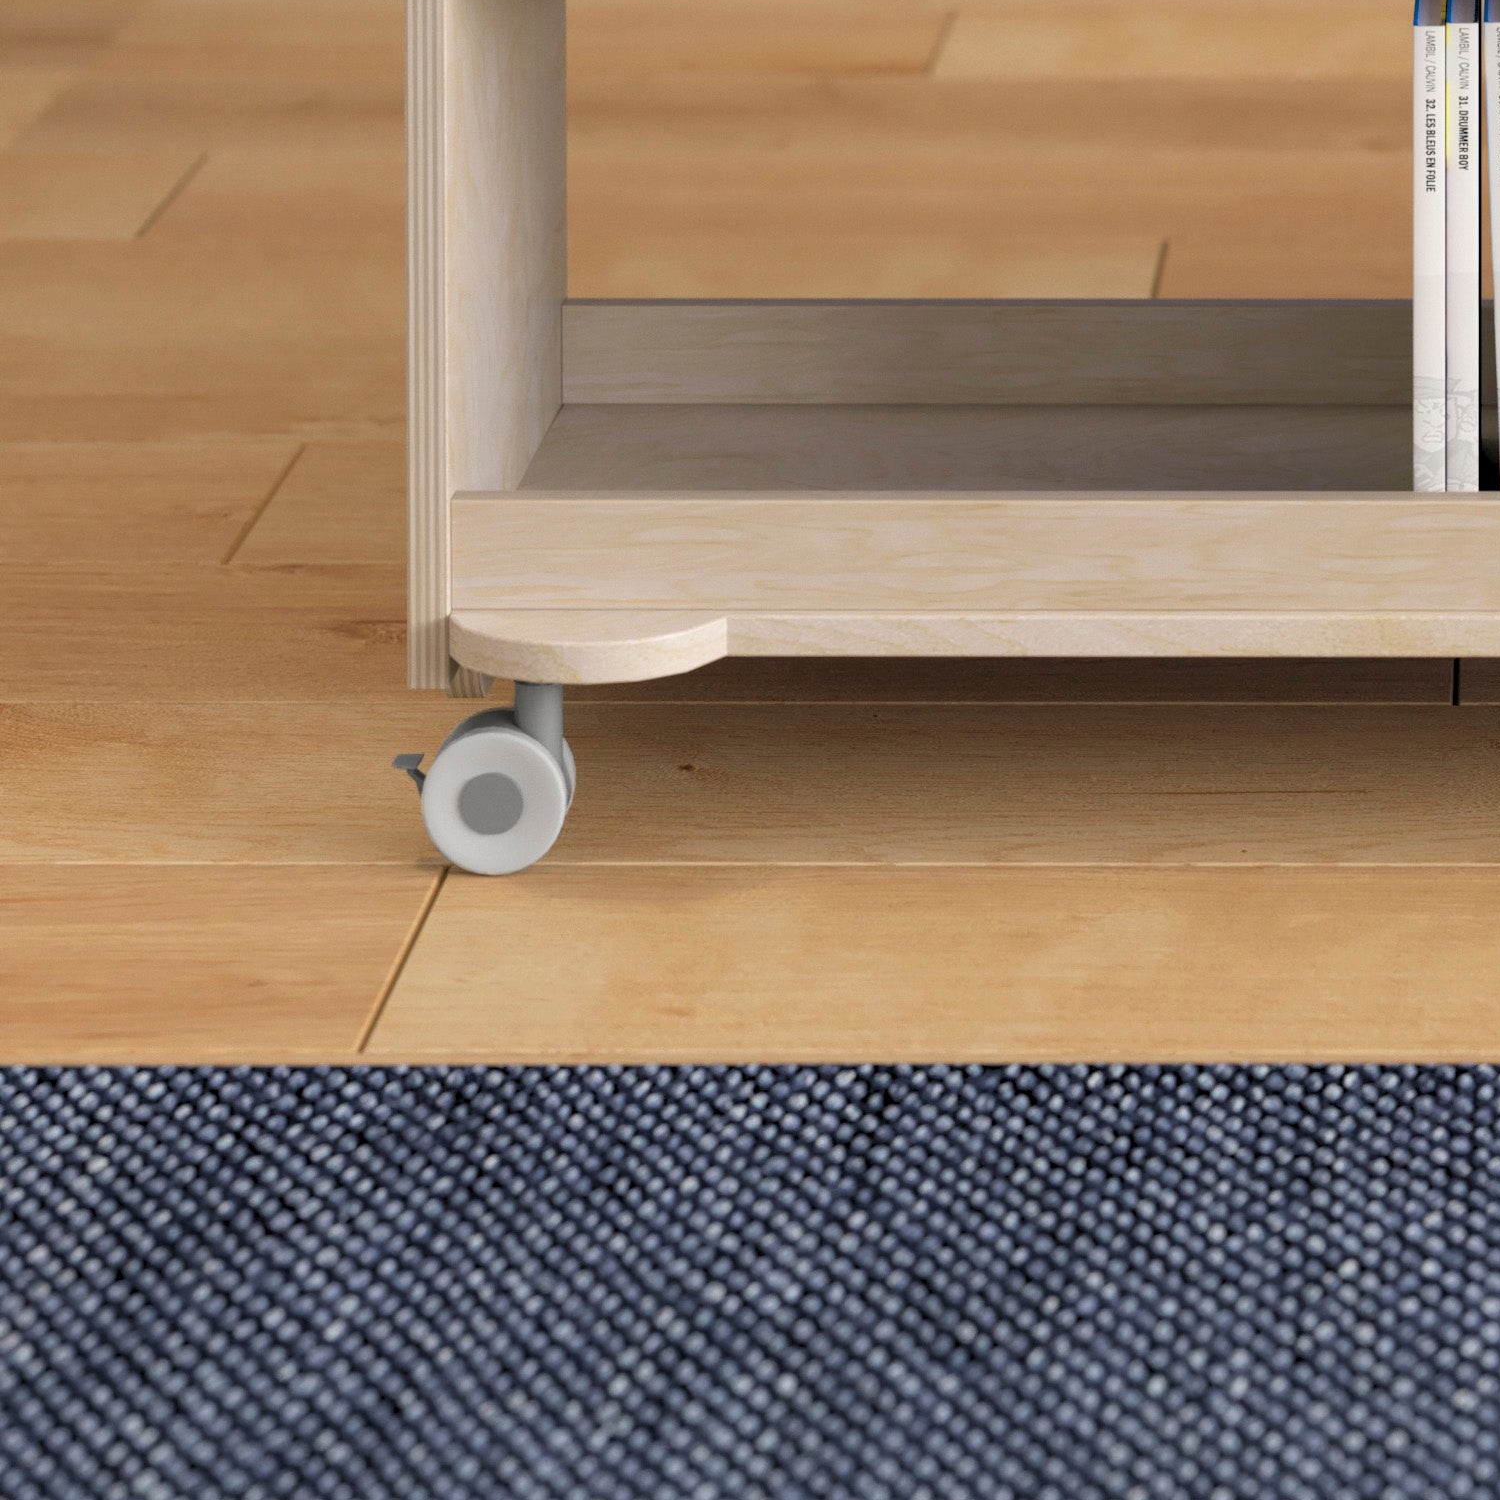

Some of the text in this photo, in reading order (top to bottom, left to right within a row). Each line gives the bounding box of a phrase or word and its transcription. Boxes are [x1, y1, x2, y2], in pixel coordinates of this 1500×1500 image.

[1426, 98, 1435, 192] 32. LES BLEUS EN FOLIE
[1459, 96, 1468, 171] 31. DRUMMER BOY
